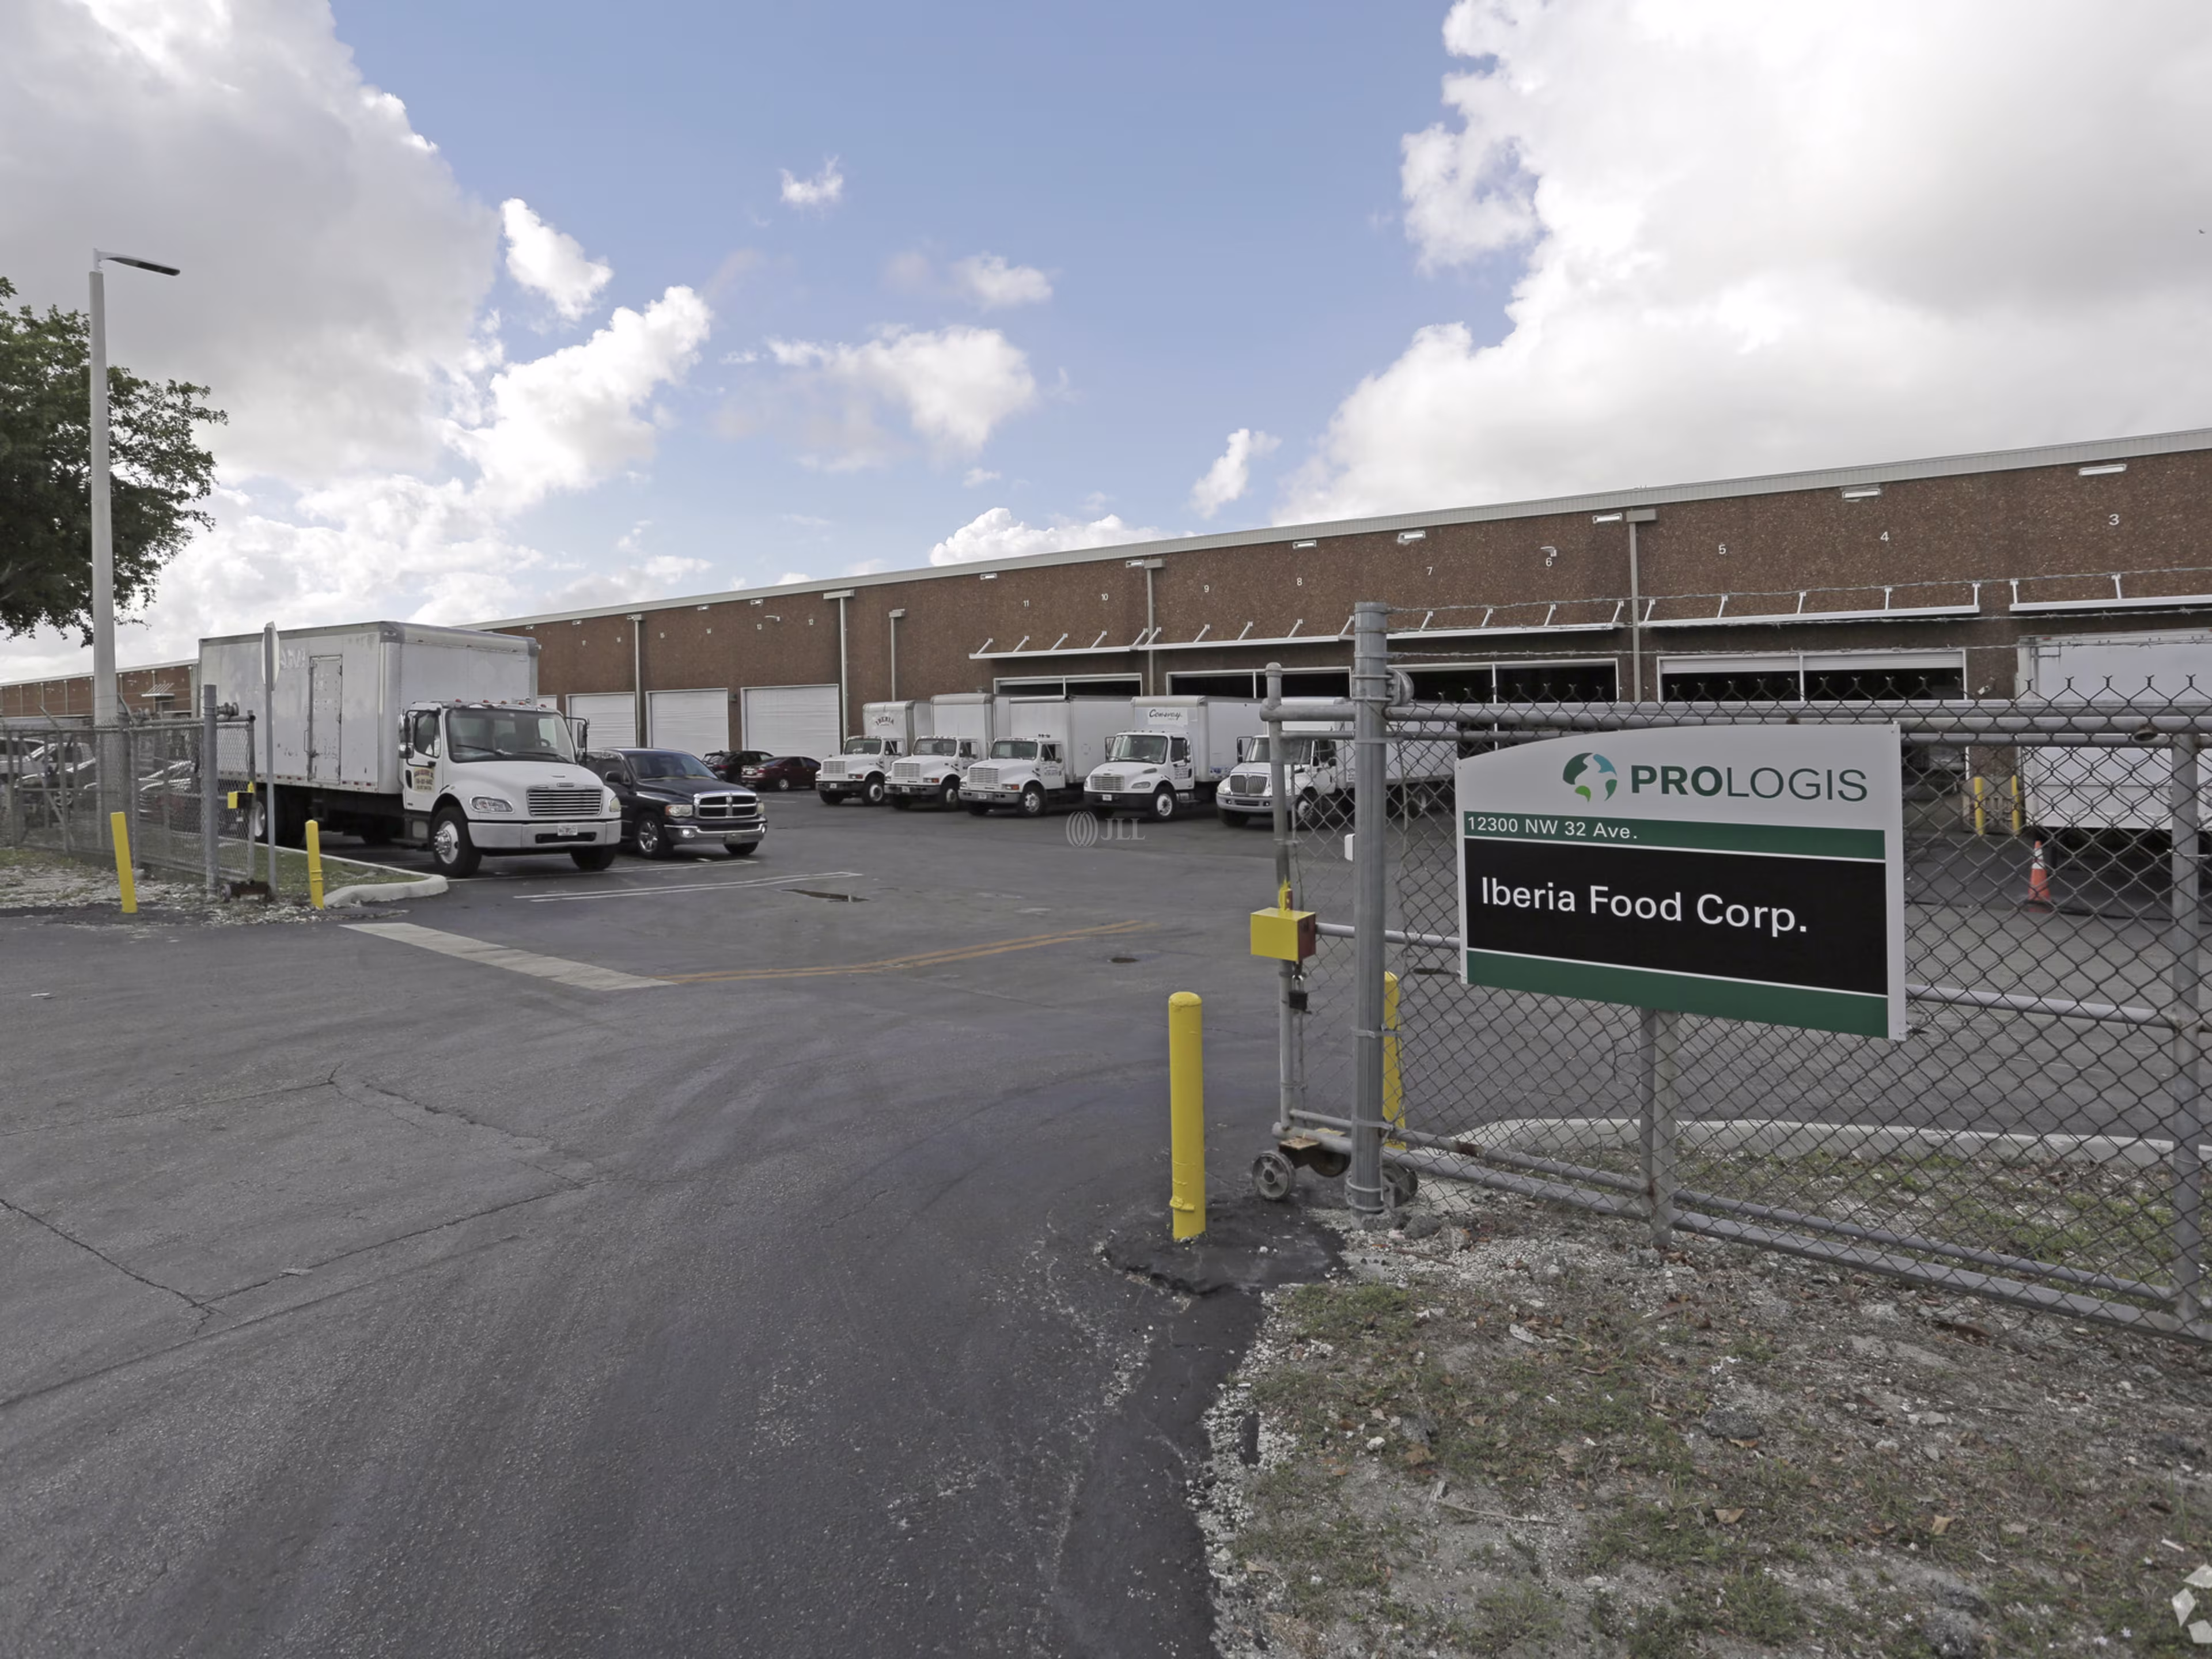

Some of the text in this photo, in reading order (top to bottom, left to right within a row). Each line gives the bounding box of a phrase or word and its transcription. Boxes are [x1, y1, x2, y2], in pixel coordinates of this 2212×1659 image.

[2109, 514, 2119, 525] 3
[1880, 532, 1889, 541] 4
[1718, 544, 1726, 554] 5
[1546, 558, 1553, 566] 6
[1427, 566, 1433, 575] 7
[1297, 578, 1302, 586] 8
[1204, 585, 1209, 593] 9
[1101, 593, 1108, 601] 10
[876, 717, 894, 726] IBERIA
[1631, 765, 1868, 802] PROLOGIS
[1468, 816, 1637, 839] 12300 NW 32 Ave.
[1482, 877, 1806, 937] Iberia Food Corp.
